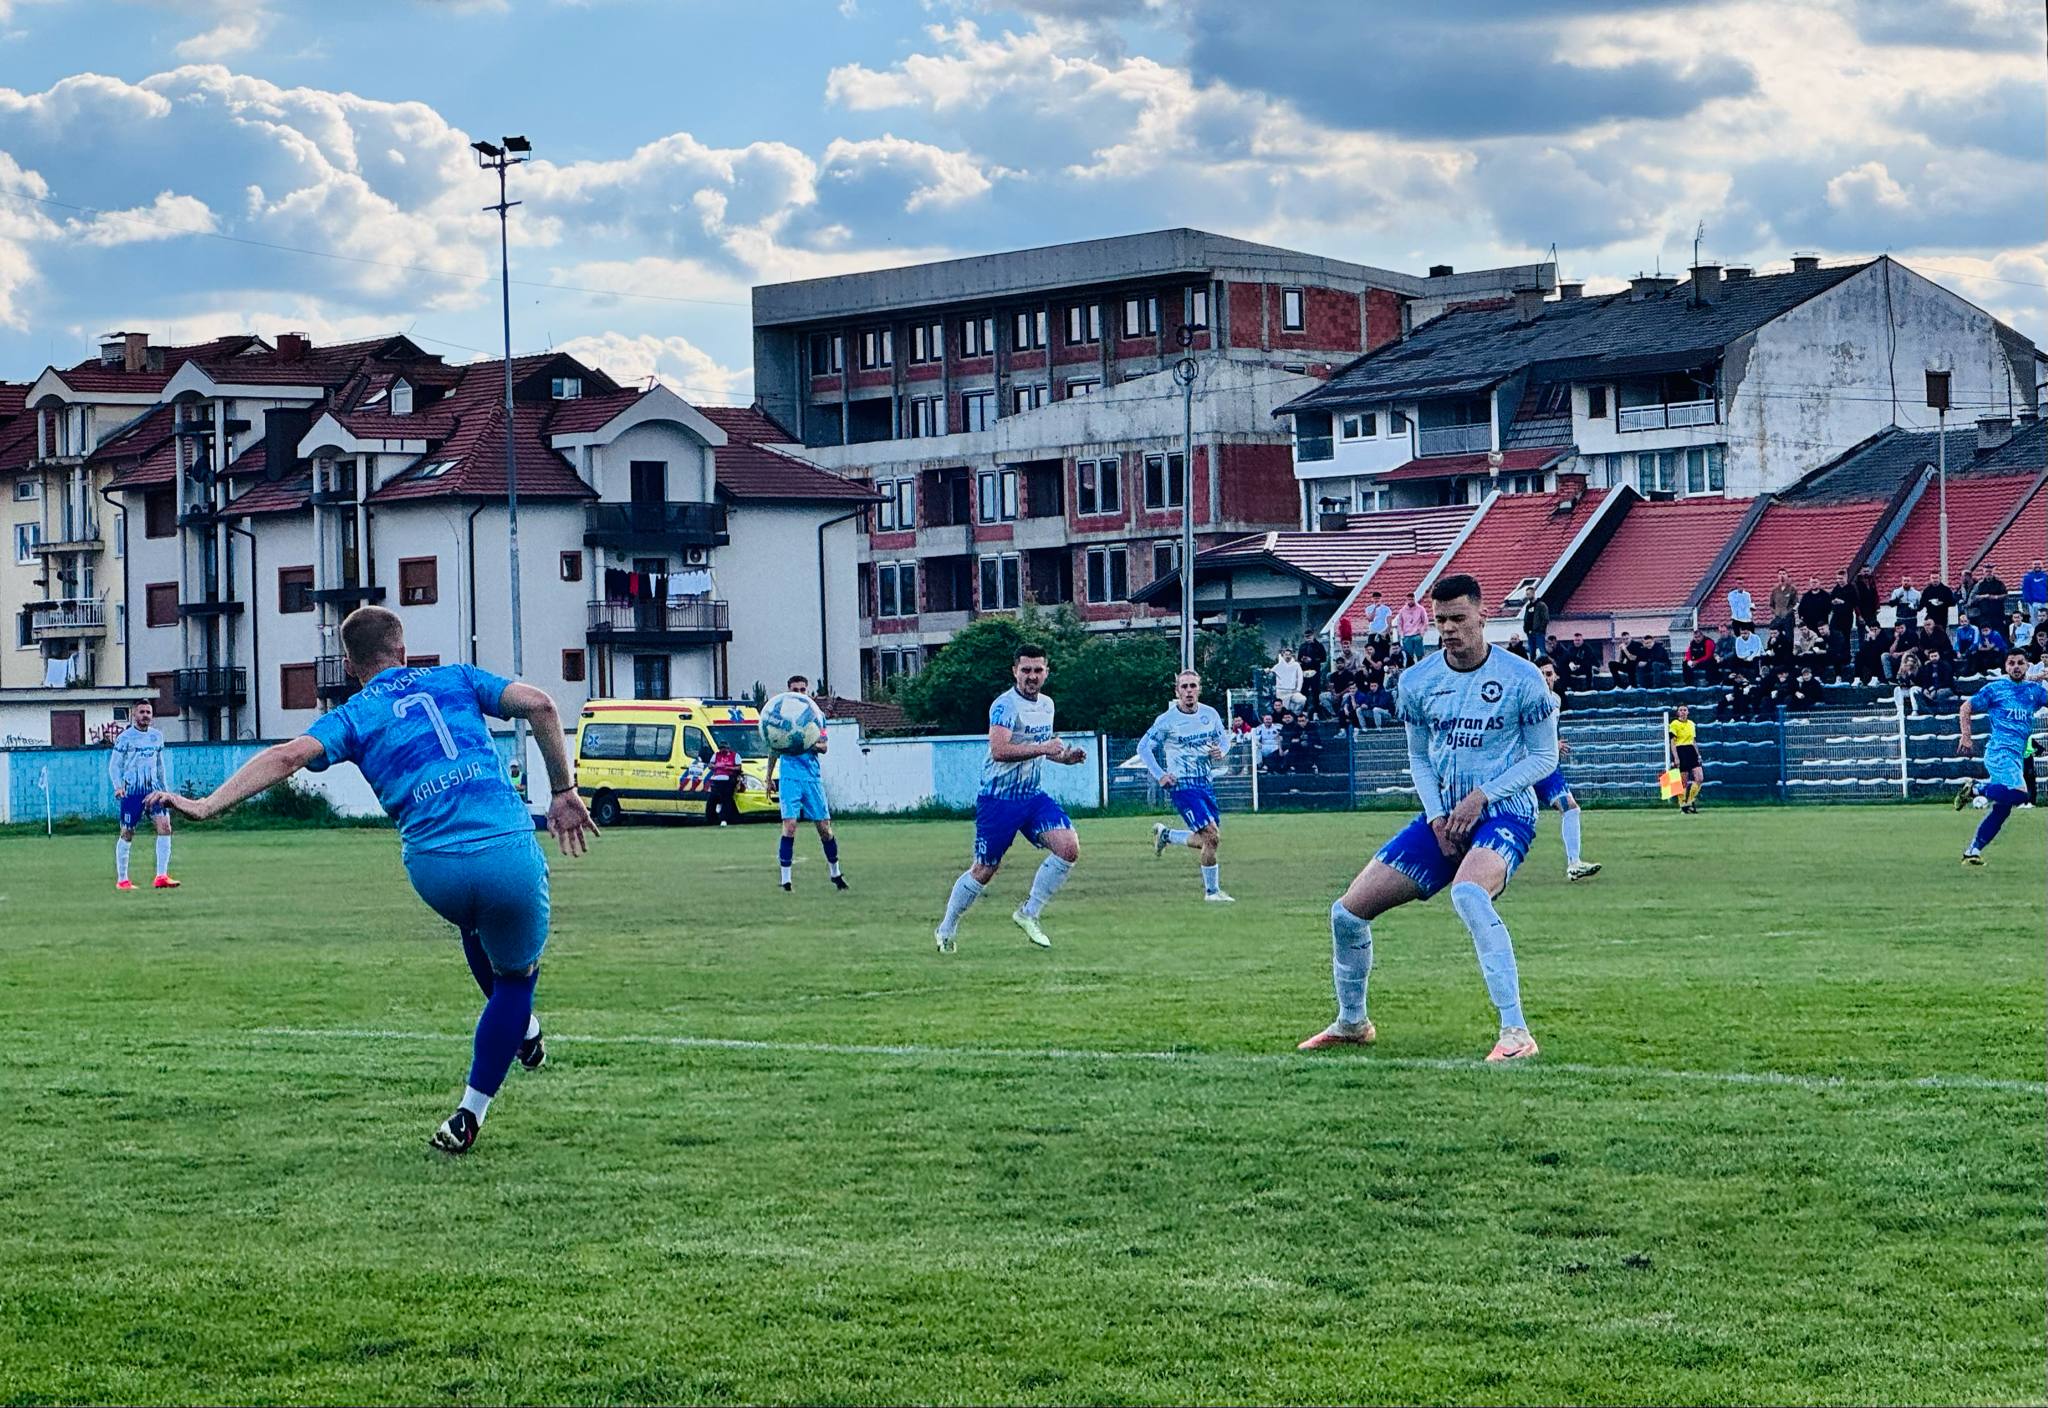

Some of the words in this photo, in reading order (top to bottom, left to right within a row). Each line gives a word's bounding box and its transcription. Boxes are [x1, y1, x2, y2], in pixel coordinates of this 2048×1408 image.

[392, 692, 459, 761] 7
[1485, 716, 1505, 731] AS
[413, 761, 482, 803] KALESIJA
